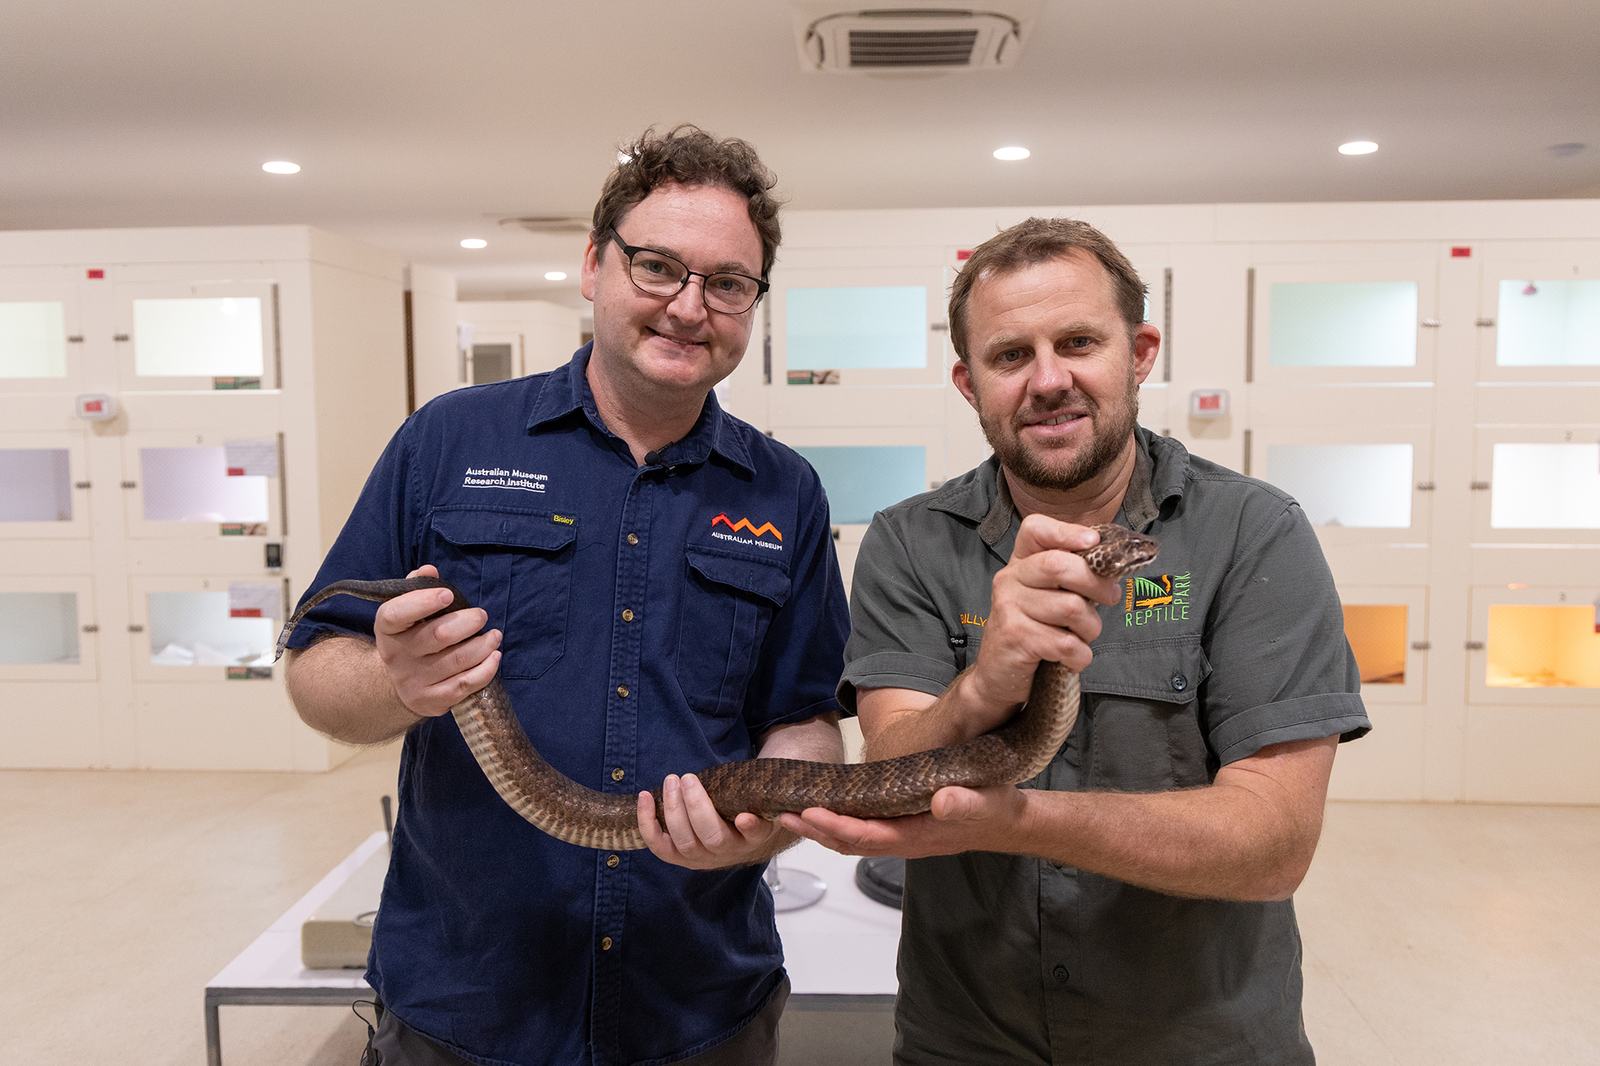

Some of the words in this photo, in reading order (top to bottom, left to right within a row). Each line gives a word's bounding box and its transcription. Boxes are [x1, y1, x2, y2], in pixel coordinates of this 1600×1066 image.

[464, 476, 506, 486] Research
[507, 479, 545, 490] Institute
[465, 467, 510, 477] Australian
[511, 469, 548, 481] Museum
[711, 531, 753, 545] AUSTRALIAN
[754, 540, 783, 551] MUSEUM
[1174, 570, 1191, 605] PARK
[1125, 605, 1190, 627] REPTILE
